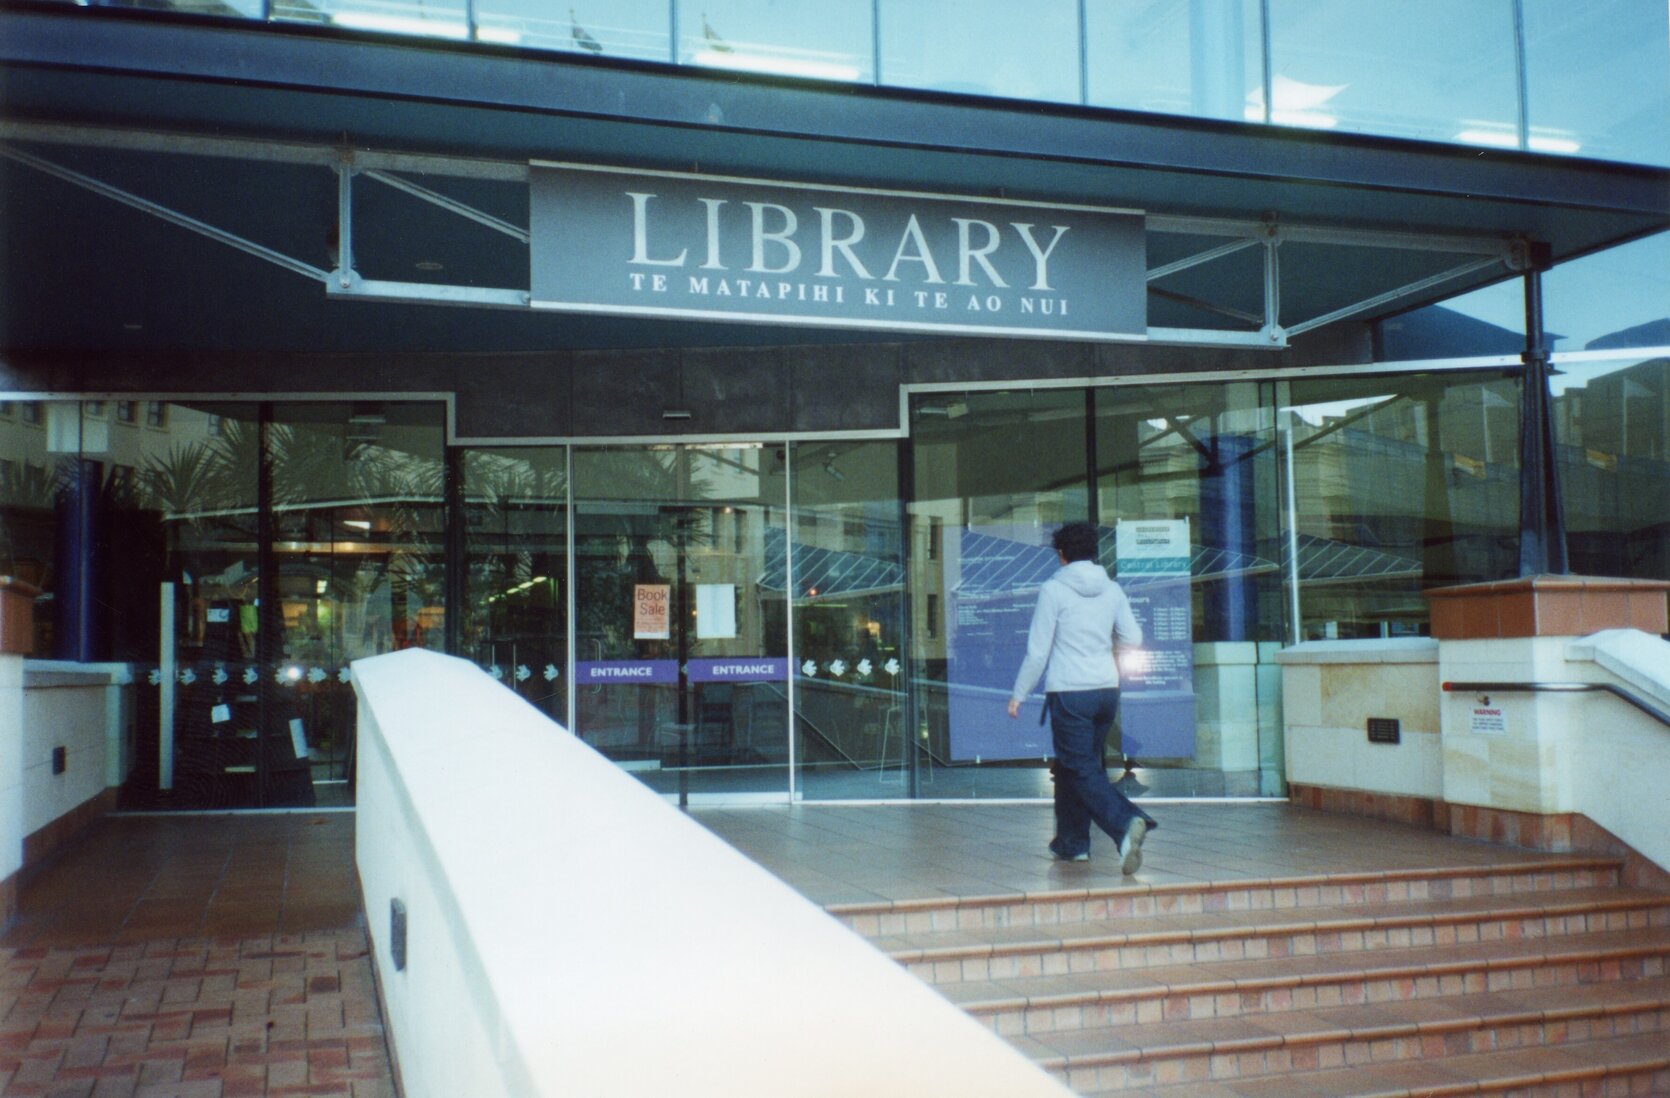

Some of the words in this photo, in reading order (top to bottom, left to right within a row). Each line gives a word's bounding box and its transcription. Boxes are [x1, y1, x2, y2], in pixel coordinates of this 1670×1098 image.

[625, 191, 1071, 291] LIBRARY
[629, 272, 668, 293] TE
[688, 275, 845, 303] MATAPIHI
[864, 288, 896, 307] KI
[914, 291, 949, 310] TE
[966, 294, 1002, 312] AO
[1020, 297, 1069, 316] NUI
[1156, 558, 1187, 570] Library
[637, 588, 667, 601] Book
[639, 602, 665, 616] Sale
[590, 667, 653, 678] ENTRANCE
[712, 664, 775, 676] ENTRANCE
